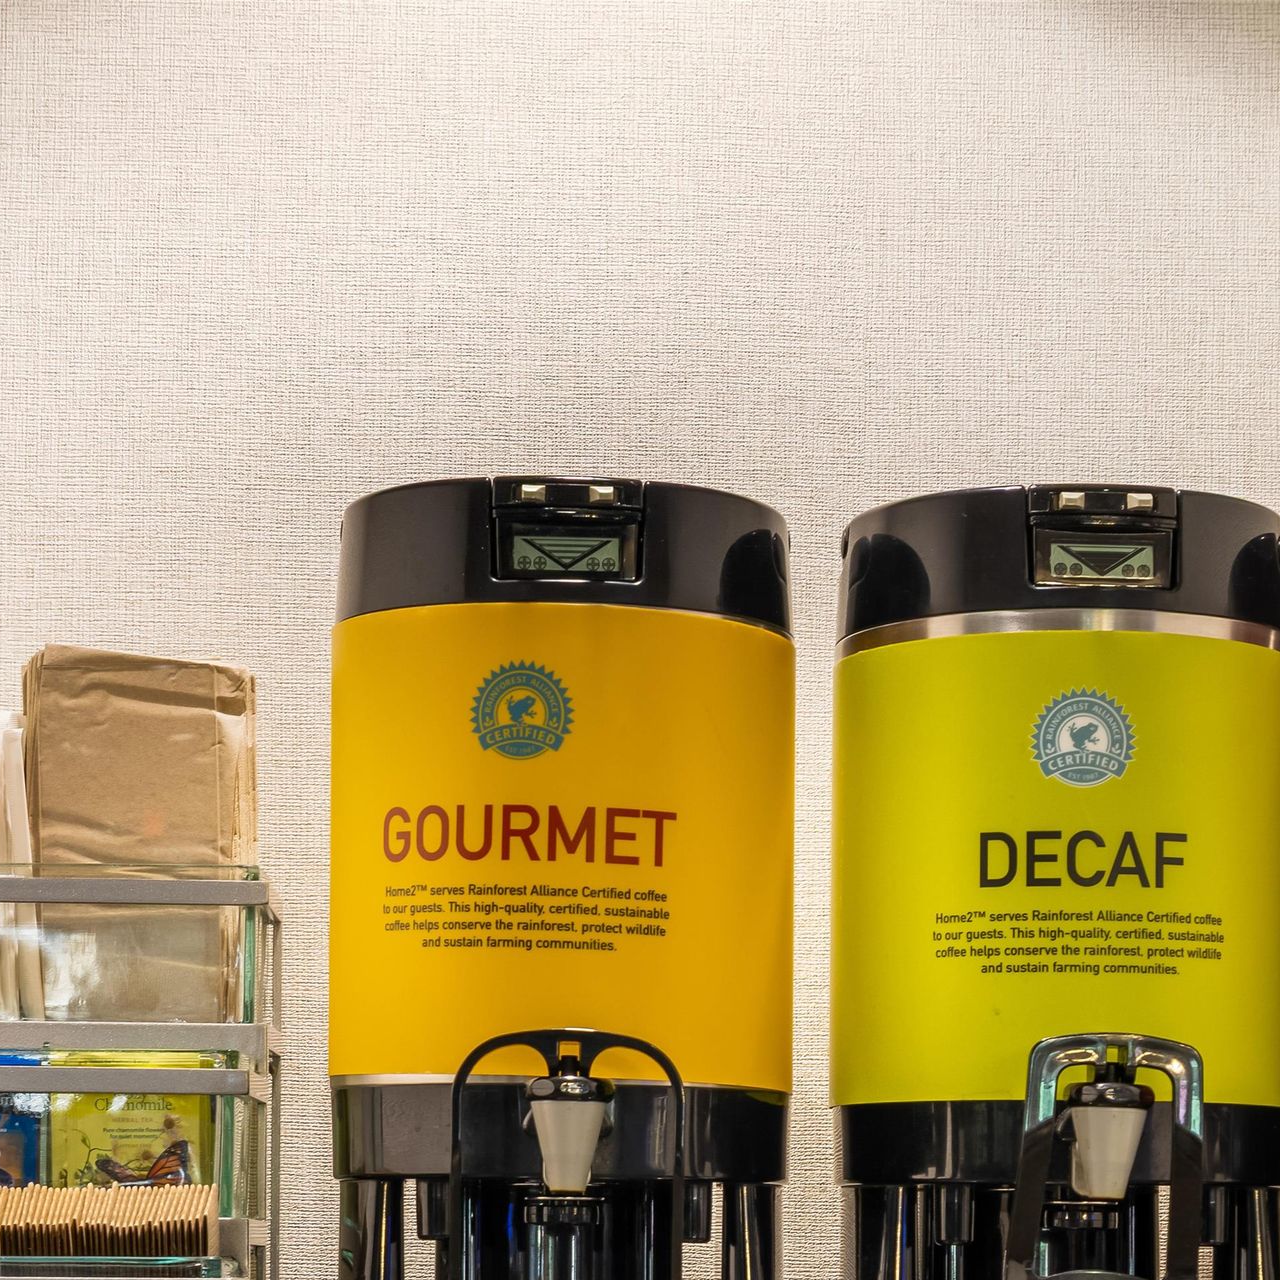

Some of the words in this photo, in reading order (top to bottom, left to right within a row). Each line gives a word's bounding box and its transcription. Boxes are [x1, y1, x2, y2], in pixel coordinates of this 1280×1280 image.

[1045, 702, 1089, 740] RAINFOREST
[1092, 704, 1121, 740] ALLIANCE
[486, 726, 556, 744] CERTIFIED
[1048, 753, 1119, 771] CERTIFIED
[382, 804, 678, 868] GOURMET
[979, 830, 1188, 889] DECAF
[430, 886, 465, 895] serves
[468, 884, 527, 896] Rainforest
[530, 885, 578, 897] Alliance
[582, 886, 631, 900] Certified
[634, 889, 667, 902] coffee
[393, 905, 407, 914] our
[410, 903, 445, 916] guests.
[448, 901, 470, 913] This
[604, 906, 670, 920] sustainable
[989, 912, 1029, 922] serves
[1032, 909, 1094, 921] Rainforest
[1096, 910, 1144, 922] Alliance
[1146, 911, 1192, 924] Certified
[1194, 914, 1223, 926] coffee
[384, 920, 410, 931] coffee
[413, 919, 439, 932] helps
[442, 920, 492, 930] conserve
[495, 919, 514, 930] the
[581, 922, 623, 935] protect
[626, 923, 666, 936] wildlife
[932, 931, 942, 941] to
[944, 931, 964, 941] our
[966, 928, 1007, 943] guests.
[1010, 927, 1035, 939] This
[1168, 931, 1224, 944] sustainable
[422, 936, 441, 948] and
[443, 936, 483, 947] sustain
[486, 936, 533, 951] farming
[535, 938, 618, 952] communities.
[935, 946, 967, 958] coffee
[970, 945, 1001, 959] helps
[1004, 946, 1058, 956] conserve
[1061, 944, 1080, 956] the
[1147, 946, 1185, 959] protect
[1187, 947, 1222, 960] wildlife
[980, 962, 1003, 974] and
[1005, 961, 1049, 973] sustain
[1052, 961, 1100, 976] farming
[1103, 963, 1180, 975] communities.
[95, 1096, 173, 1111] Chmomile
